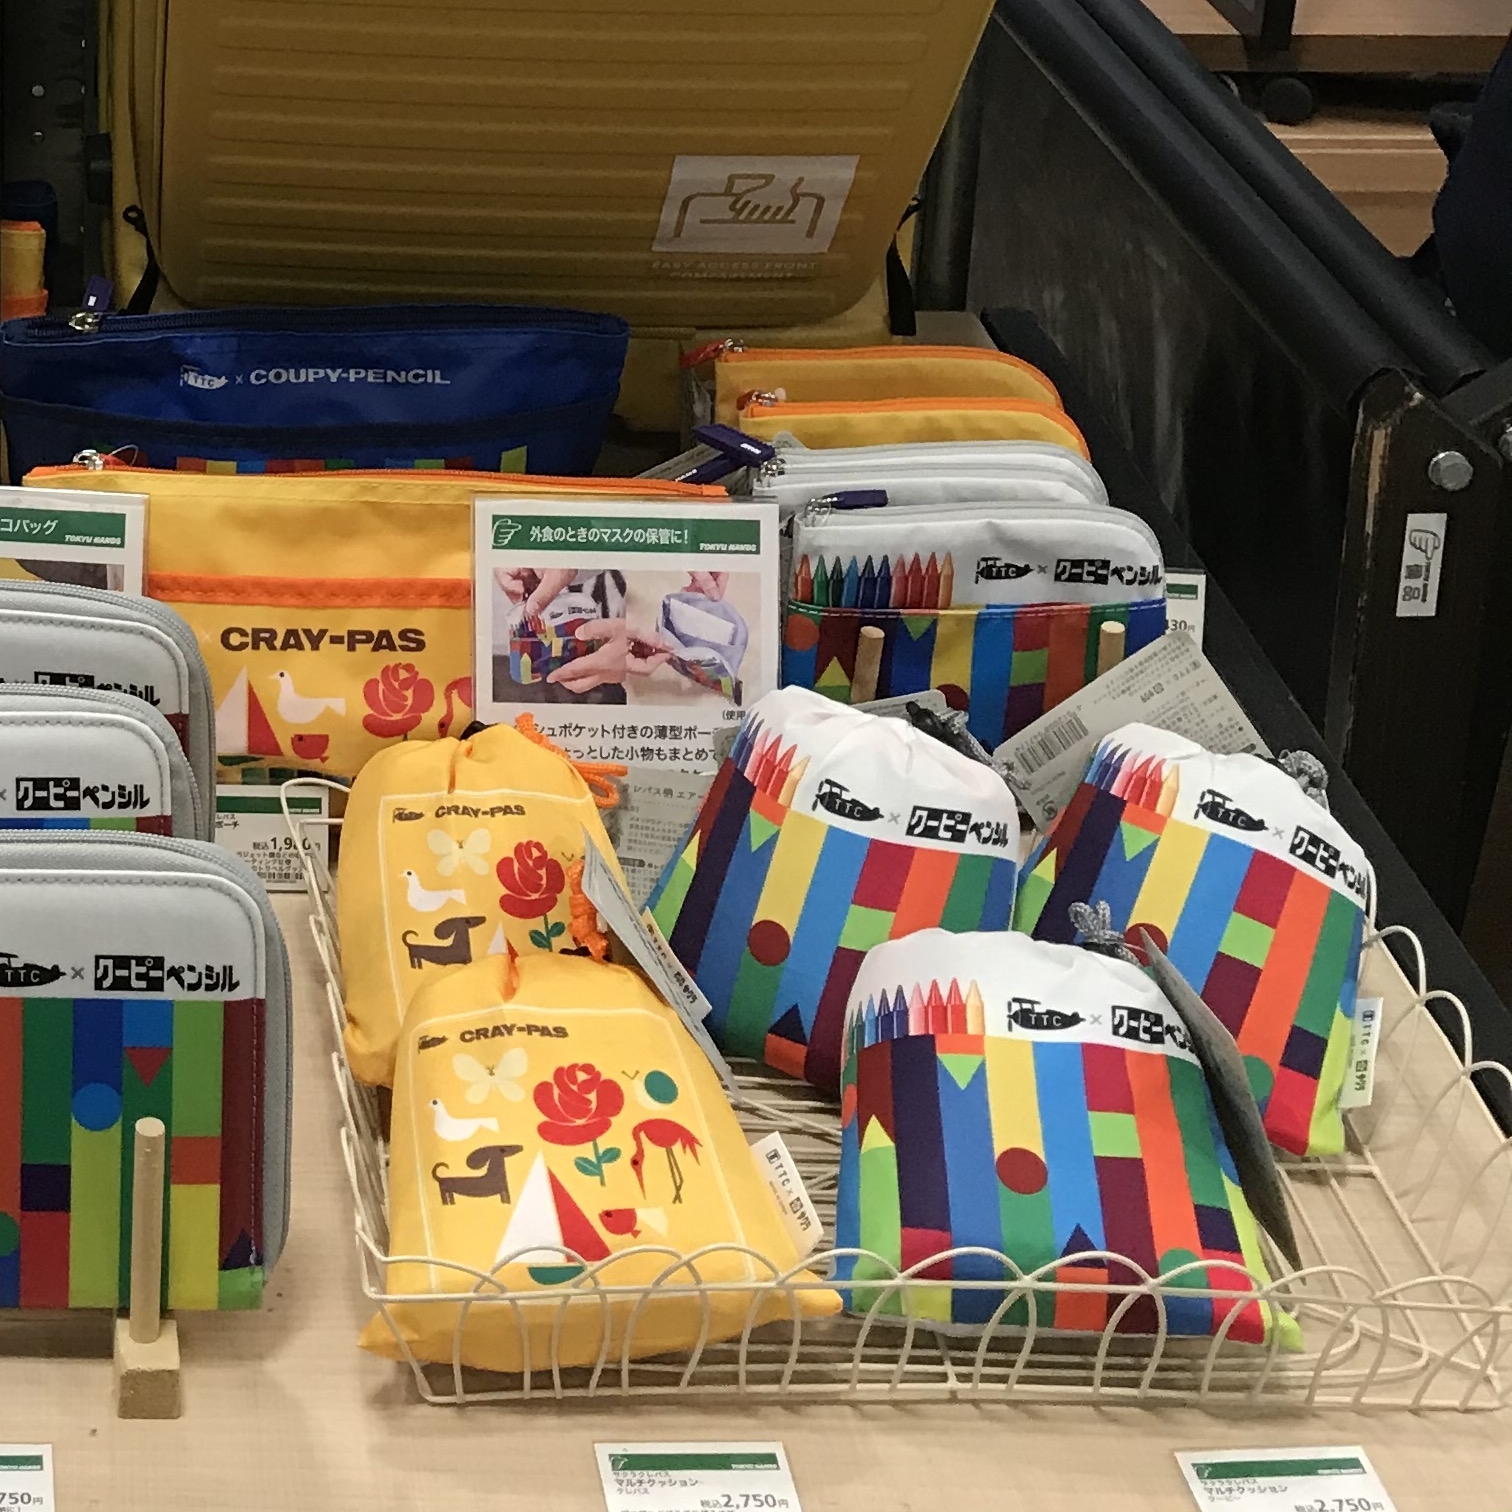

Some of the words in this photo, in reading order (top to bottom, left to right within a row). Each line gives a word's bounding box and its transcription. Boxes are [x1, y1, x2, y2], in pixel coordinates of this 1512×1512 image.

[249, 366, 451, 387] COUPY-PENCIL
[991, 567, 1016, 577] TTC
[1054, 558, 1162, 586] クーピーペンシル
[220, 626, 426, 653] CRAY-PAS
[16, 777, 151, 811] クーピーペンシル
[434, 804, 526, 819] CRAY-PAS
[835, 798, 864, 818] TTC
[1218, 807, 1247, 827] TTC
[3, 969, 41, 983] TTC
[94, 955, 240, 993] クーピーペンシル
[1029, 1013, 1062, 1027] TTC
[459, 1022, 569, 1043] CRAY-PAS
[615, 1478, 699, 1488] マルチクッション
